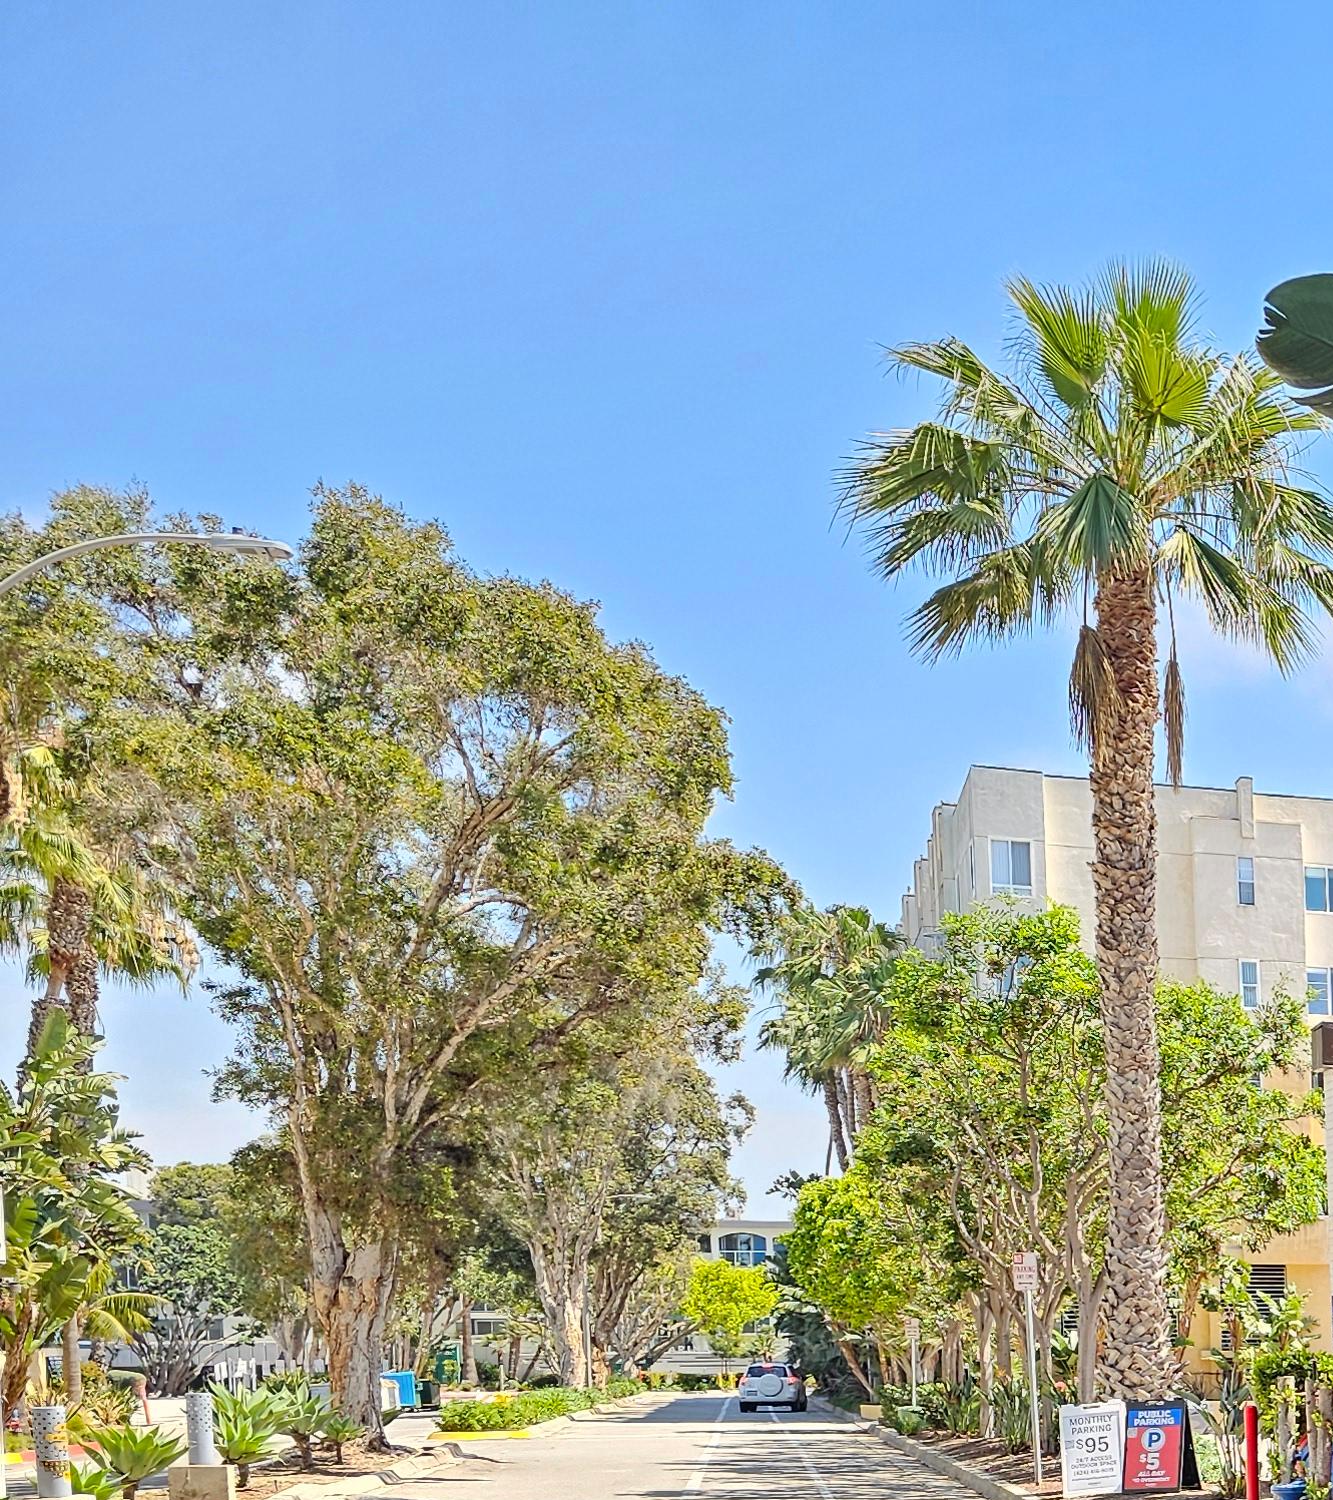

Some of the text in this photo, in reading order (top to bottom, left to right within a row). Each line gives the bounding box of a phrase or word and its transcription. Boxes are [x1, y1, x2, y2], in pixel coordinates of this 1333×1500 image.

[1069, 1414, 1113, 1426] MONTHLY
[1138, 1410, 1172, 1418] PUBLIC
[1134, 1417, 1175, 1426] PARKING
[1071, 1424, 1112, 1435] PARKING
[1076, 1436, 1109, 1454] $95
[1148, 1432, 1162, 1448] P
[1139, 1452, 1160, 1470] $5
